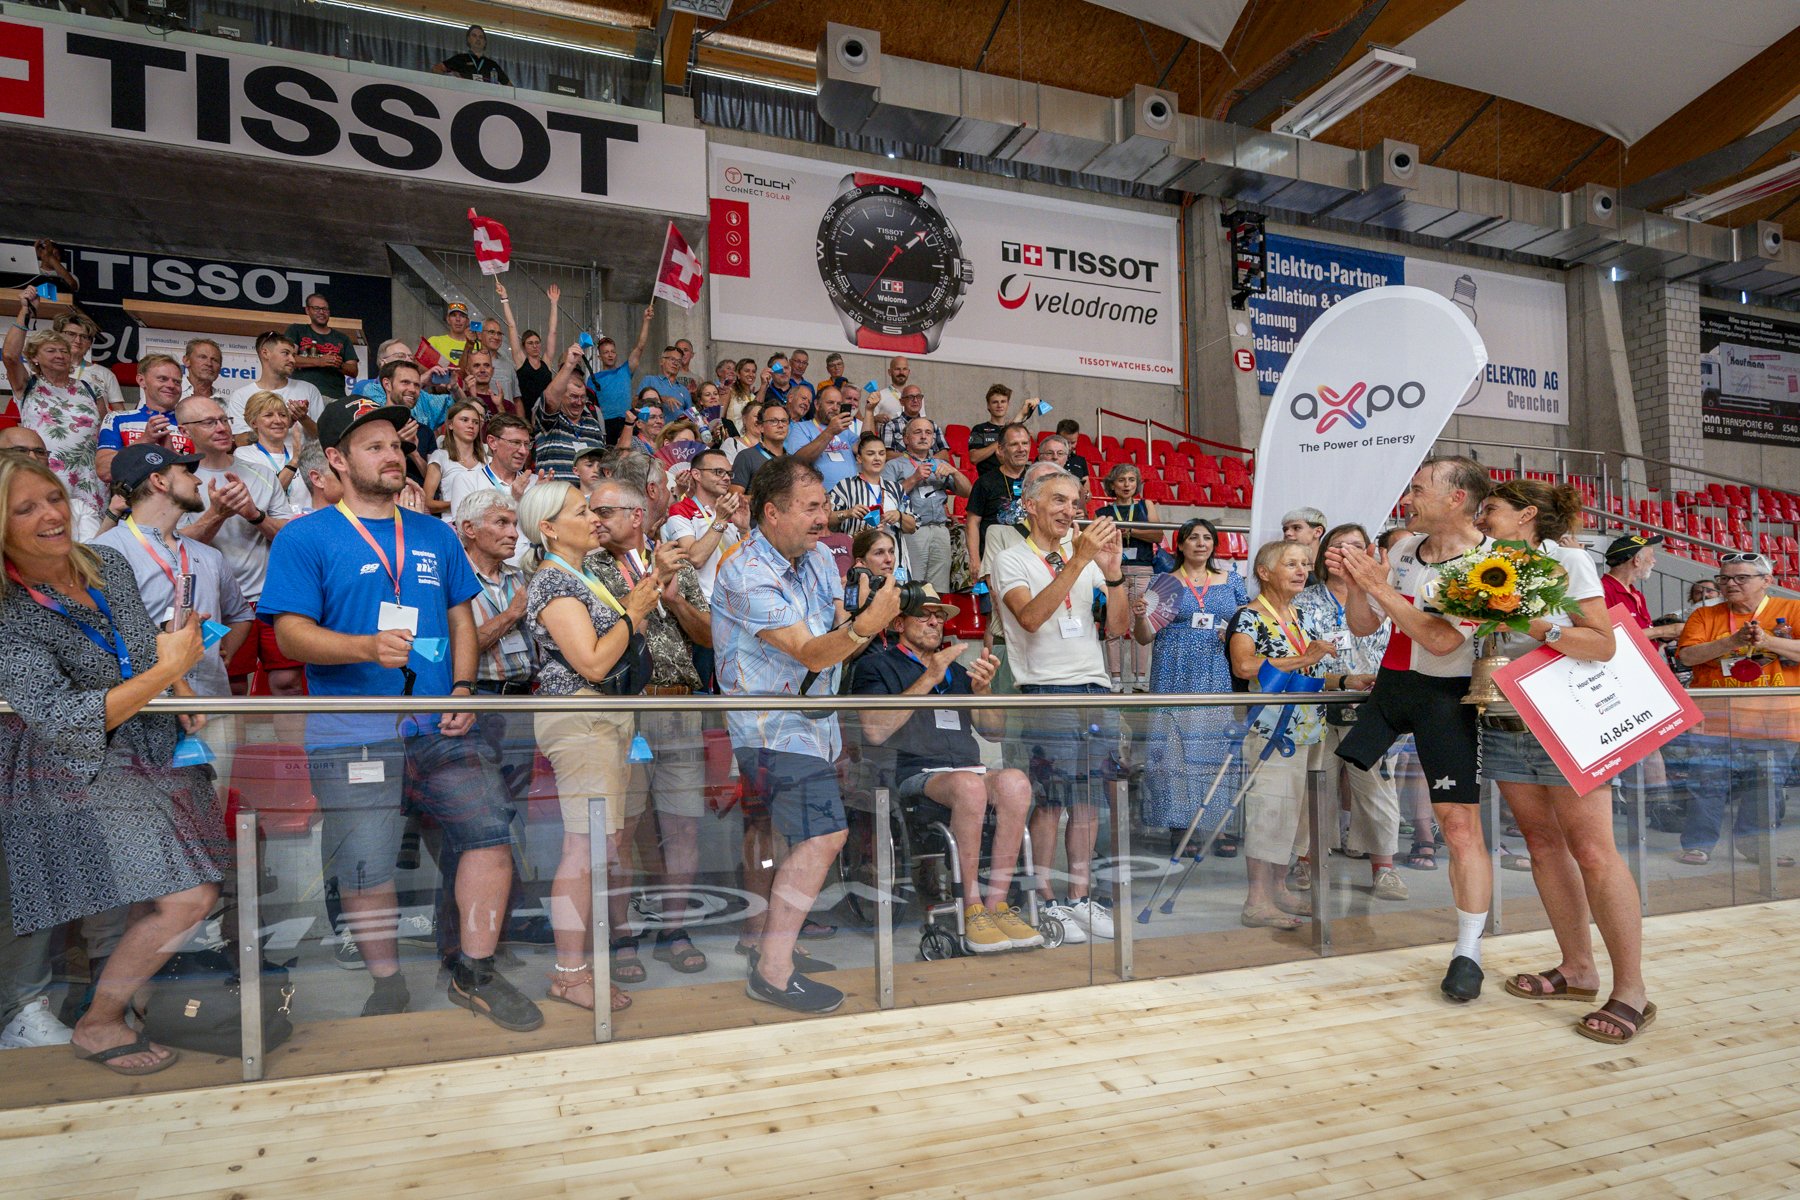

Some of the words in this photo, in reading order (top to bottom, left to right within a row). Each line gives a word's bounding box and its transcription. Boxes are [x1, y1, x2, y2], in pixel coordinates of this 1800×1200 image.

[66, 31, 639, 197] TISSOT
[724, 185, 763, 197] CONNECT
[765, 190, 791, 201] SOLAR
[877, 226, 905, 237] TISSOT
[1046, 246, 1159, 282] TISSOT
[1266, 251, 1388, 289] Elektro-Partner
[80, 250, 330, 306] TISSOT
[877, 293, 908, 305] Welcome
[1035, 292, 1157, 325] velodrome
[1249, 307, 1297, 333] Planung
[1079, 357, 1174, 374] TISSOTWATCHES.COM
[1238, 351, 1252, 369] E
[1486, 363, 1537, 388] ELEKTRO
[1543, 370, 1559, 391] AG
[1290, 381, 1426, 434] axpo
[1507, 390, 1560, 414] Grenchen
[1299, 443, 1320, 453] The
[1323, 438, 1358, 451] Power
[1361, 436, 1374, 447] of
[1376, 433, 1416, 446] Energy
[1589, 670, 1605, 684] Record
[1600, 718, 1634, 746] 41,845
[1633, 709, 1654, 726] km
